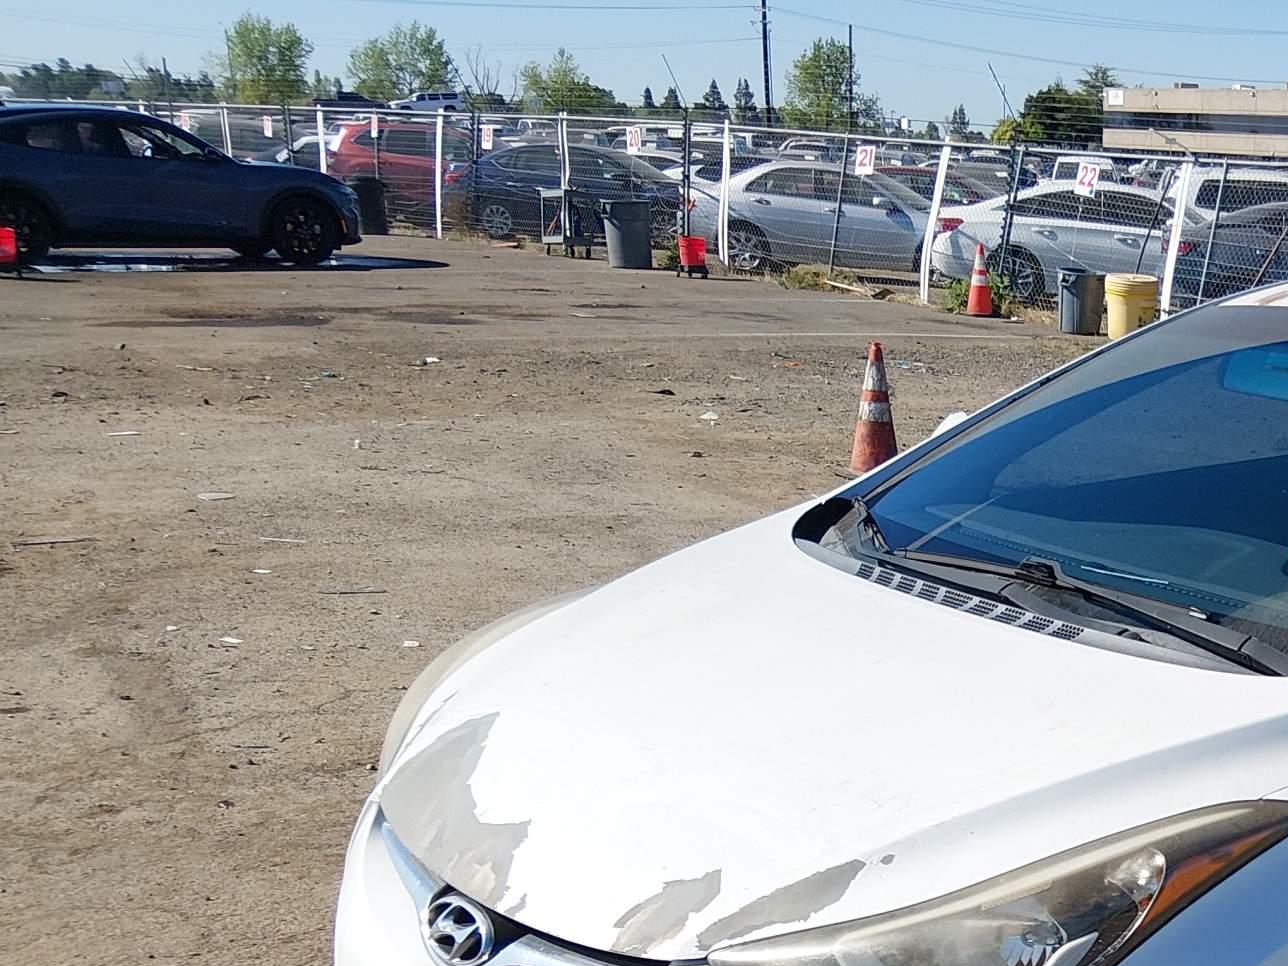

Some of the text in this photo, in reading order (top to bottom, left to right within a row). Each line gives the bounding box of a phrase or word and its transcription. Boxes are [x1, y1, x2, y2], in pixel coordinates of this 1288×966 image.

[482, 127, 492, 143] 19
[628, 129, 640, 147] 20
[858, 148, 874, 167] 21
[1078, 165, 1097, 188] 22
